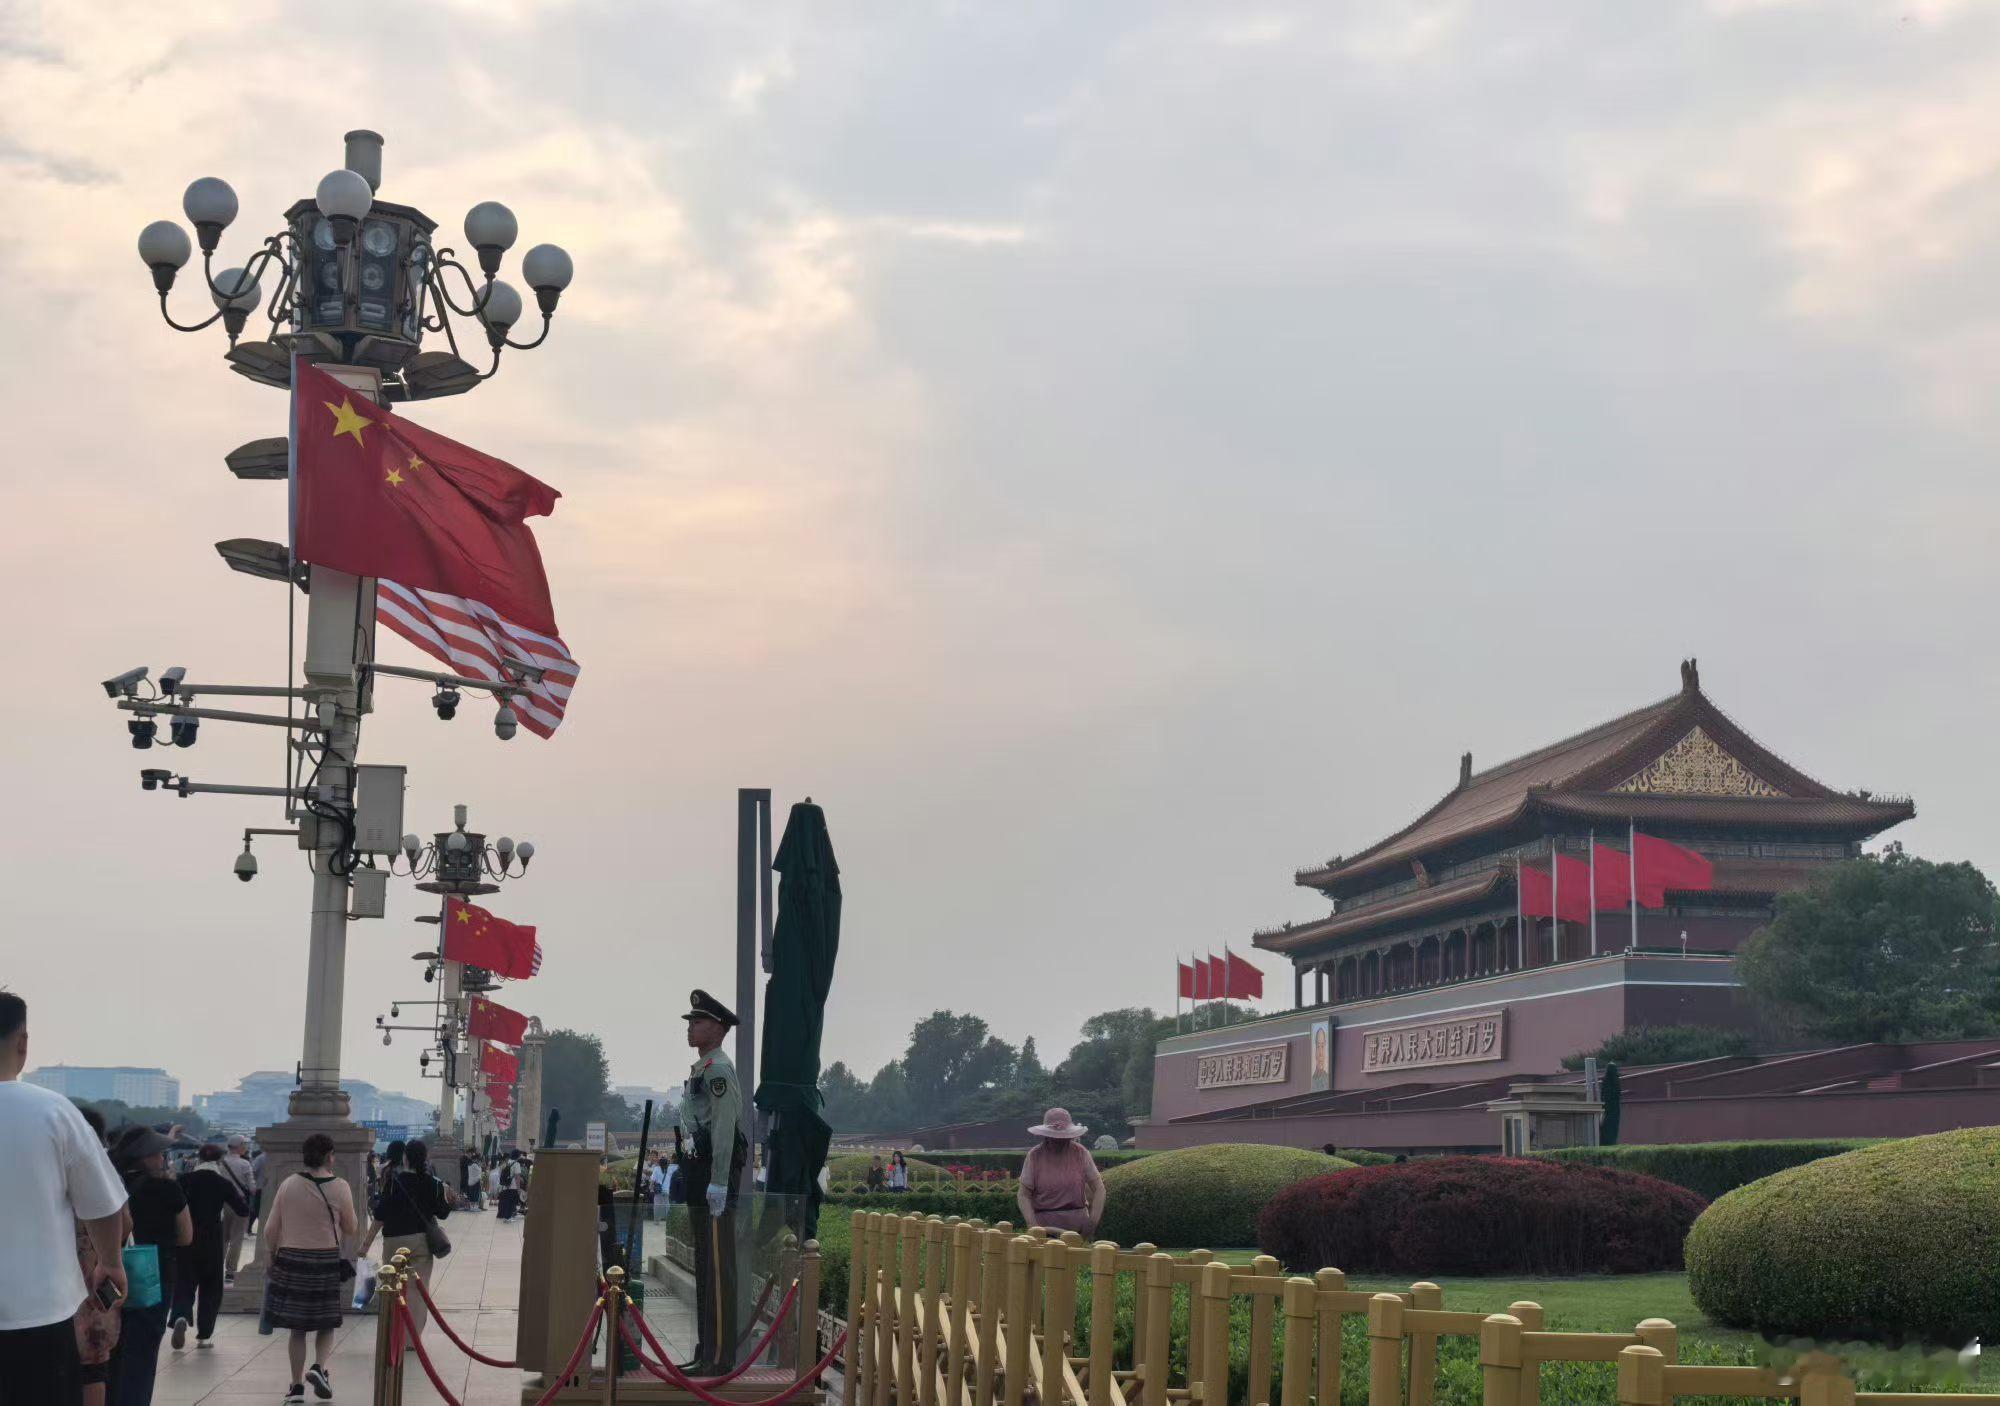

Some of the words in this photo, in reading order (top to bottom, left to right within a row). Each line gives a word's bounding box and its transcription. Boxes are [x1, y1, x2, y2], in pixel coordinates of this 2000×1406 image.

[1368, 1022, 1496, 1066] 世界人民大团结万岁
[1200, 1050, 1283, 1083] 中华人民共和国万岁
